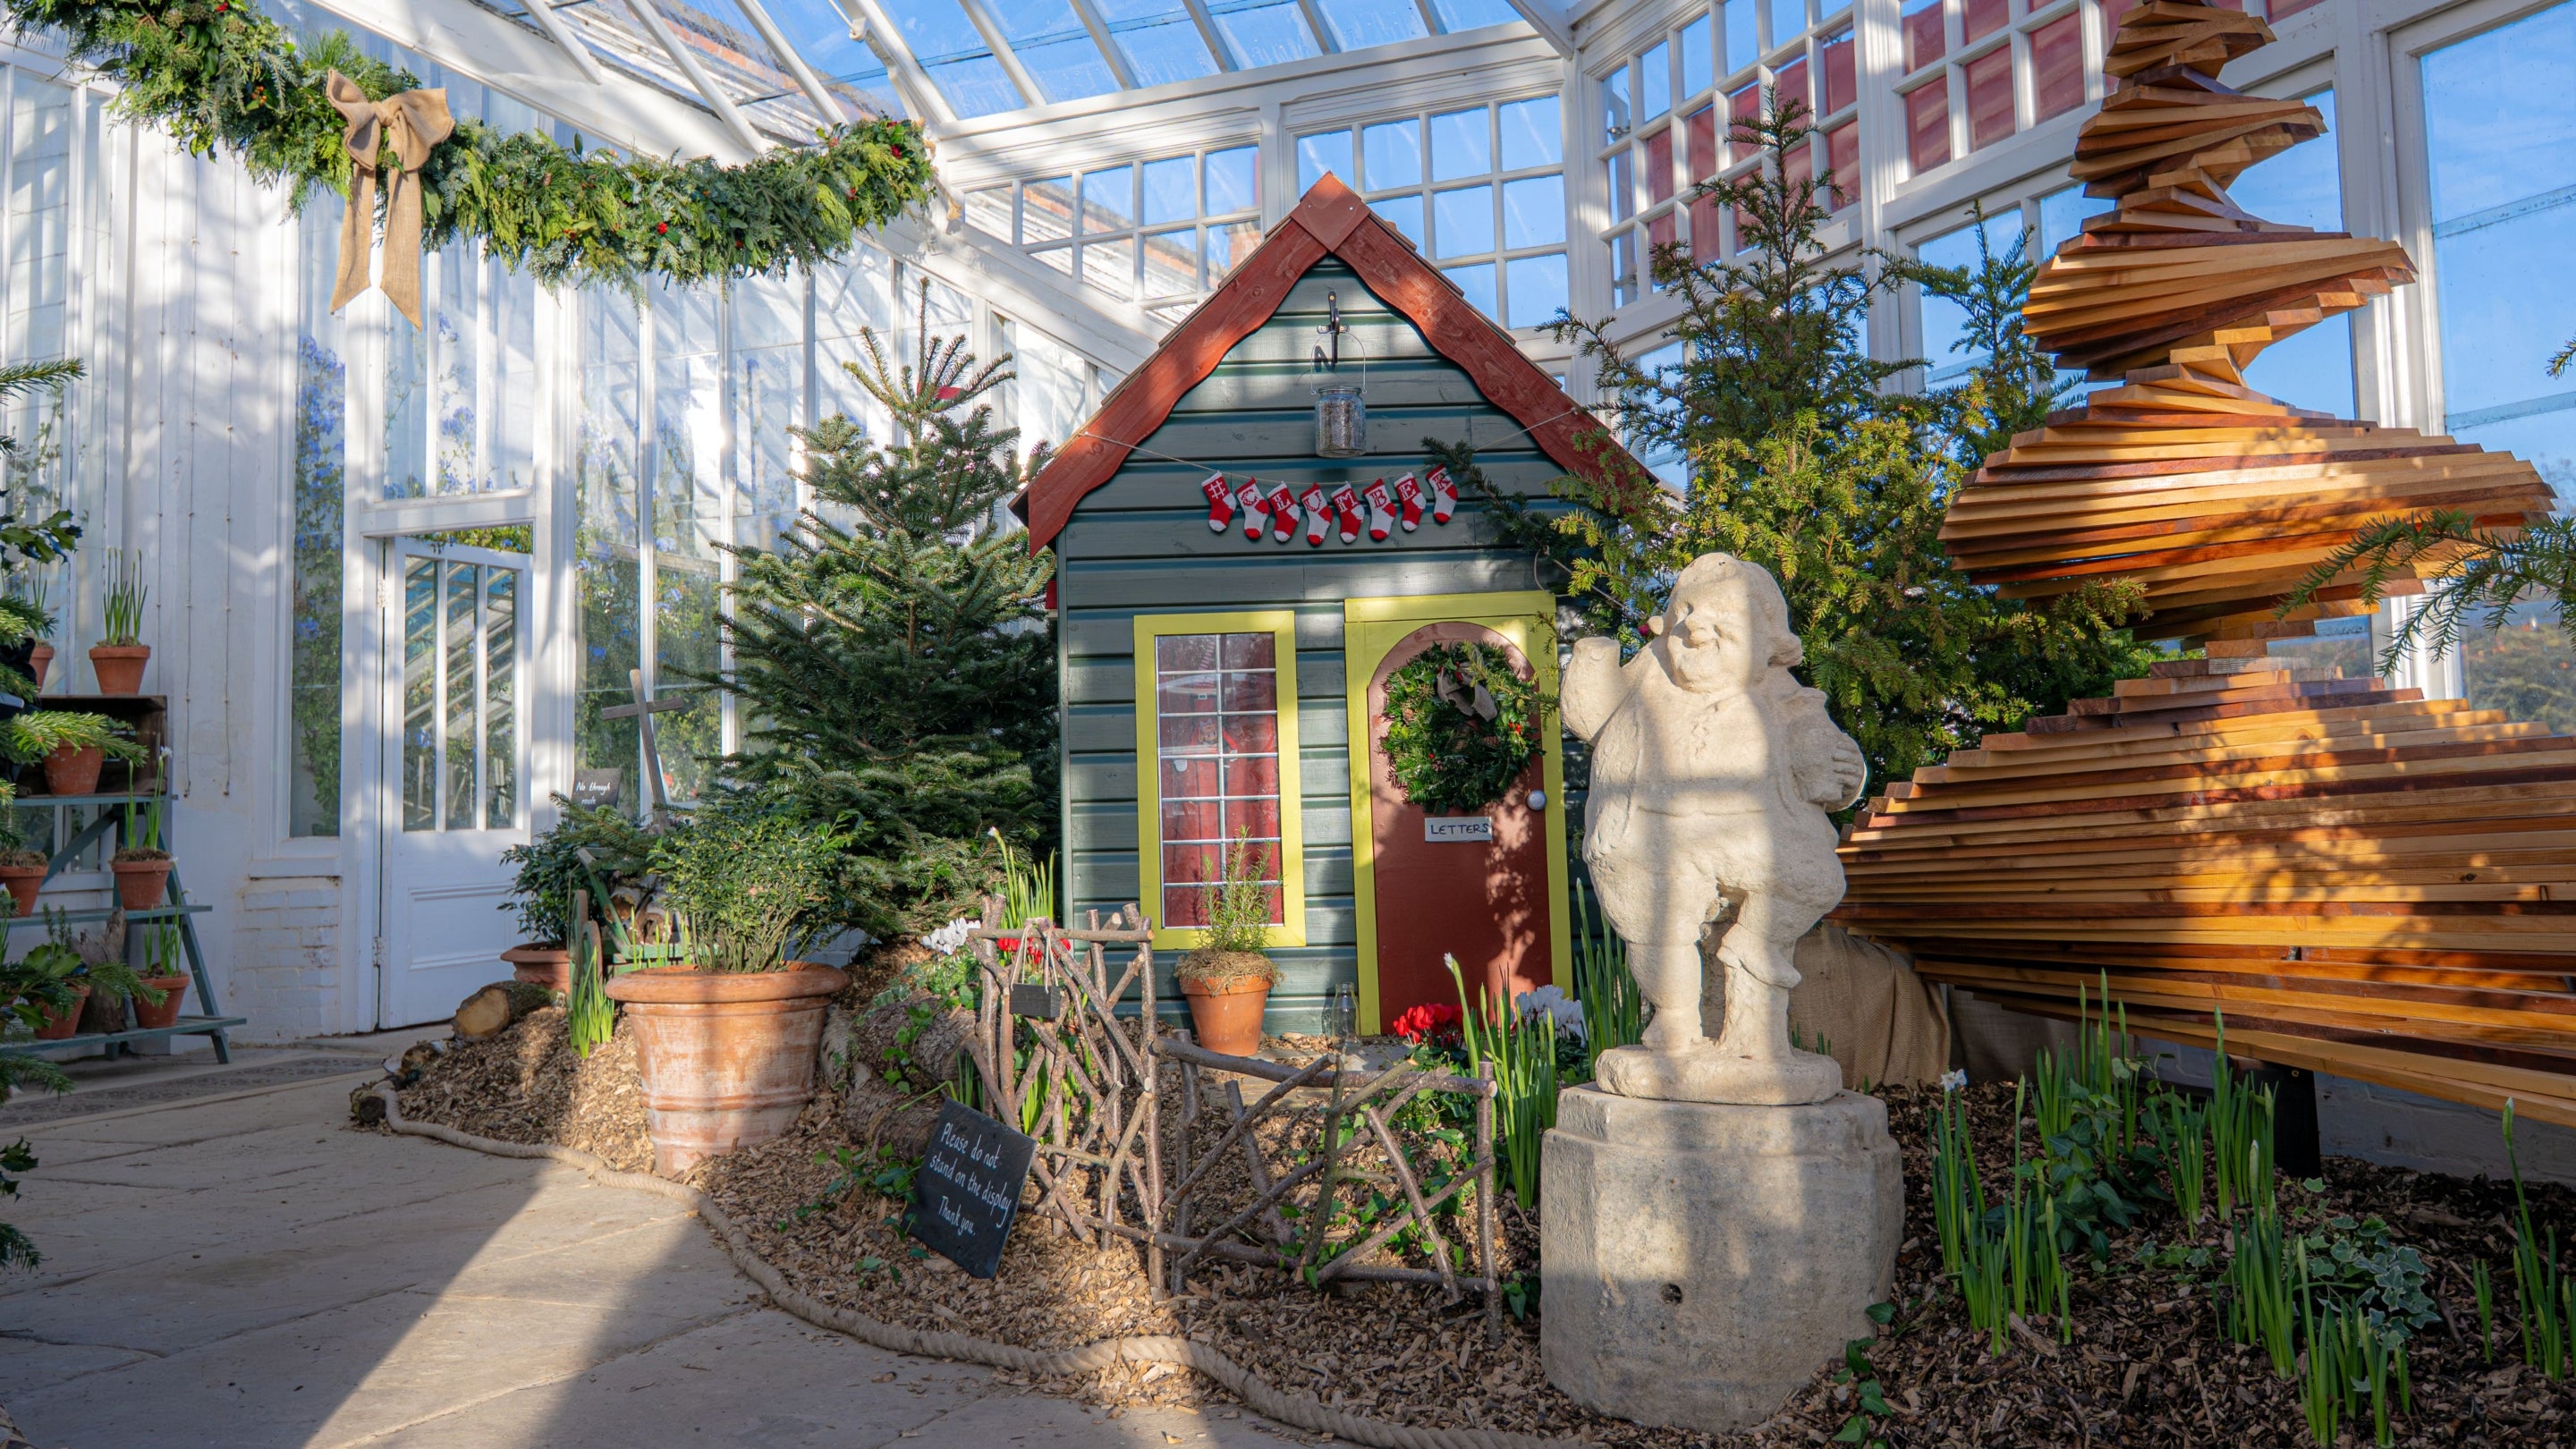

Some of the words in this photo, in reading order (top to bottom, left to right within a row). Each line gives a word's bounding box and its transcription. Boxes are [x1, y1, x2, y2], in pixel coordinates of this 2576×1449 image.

[575, 781, 586, 792] No
[589, 781, 611, 796] through
[1430, 823, 1489, 835] LETTERS
[940, 1122, 969, 1154] Please
[970, 1134, 983, 1162] do
[983, 1144, 1002, 1169] not
[929, 1151, 958, 1181] stand
[954, 1170, 966, 1188] on
[967, 1172, 980, 1197] the
[981, 1182, 1013, 1228] display
[938, 1195, 962, 1226] Thank
[957, 1218, 976, 1236] you.
